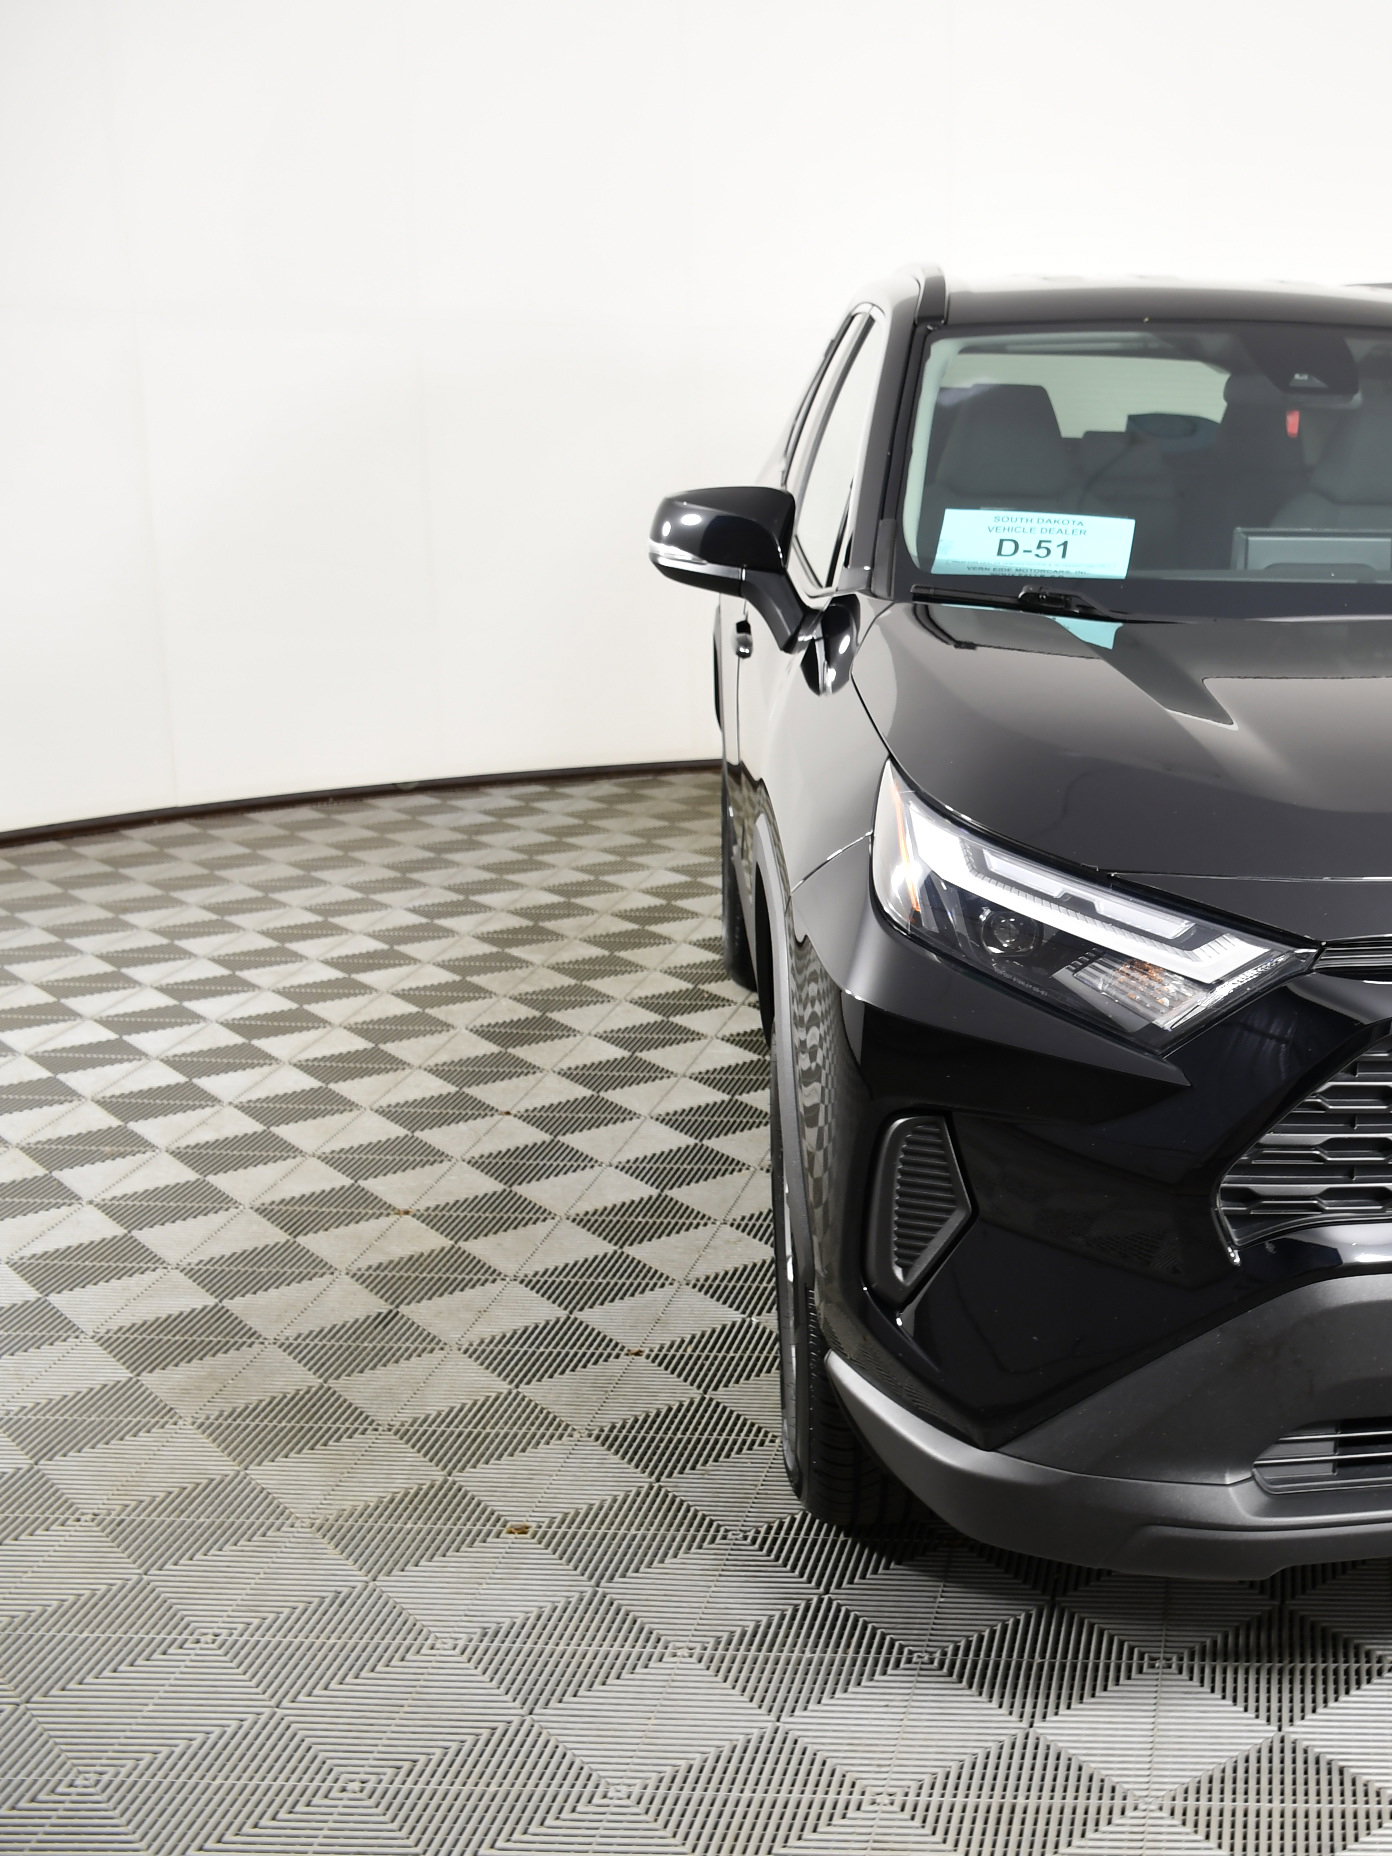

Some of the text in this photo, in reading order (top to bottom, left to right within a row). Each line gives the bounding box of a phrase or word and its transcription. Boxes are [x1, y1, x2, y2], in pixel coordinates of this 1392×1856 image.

[993, 515, 1085, 527] SOUTH DAKOTA
[987, 525, 1087, 536] VEHICLE DEALER
[996, 538, 1069, 560] D-51
